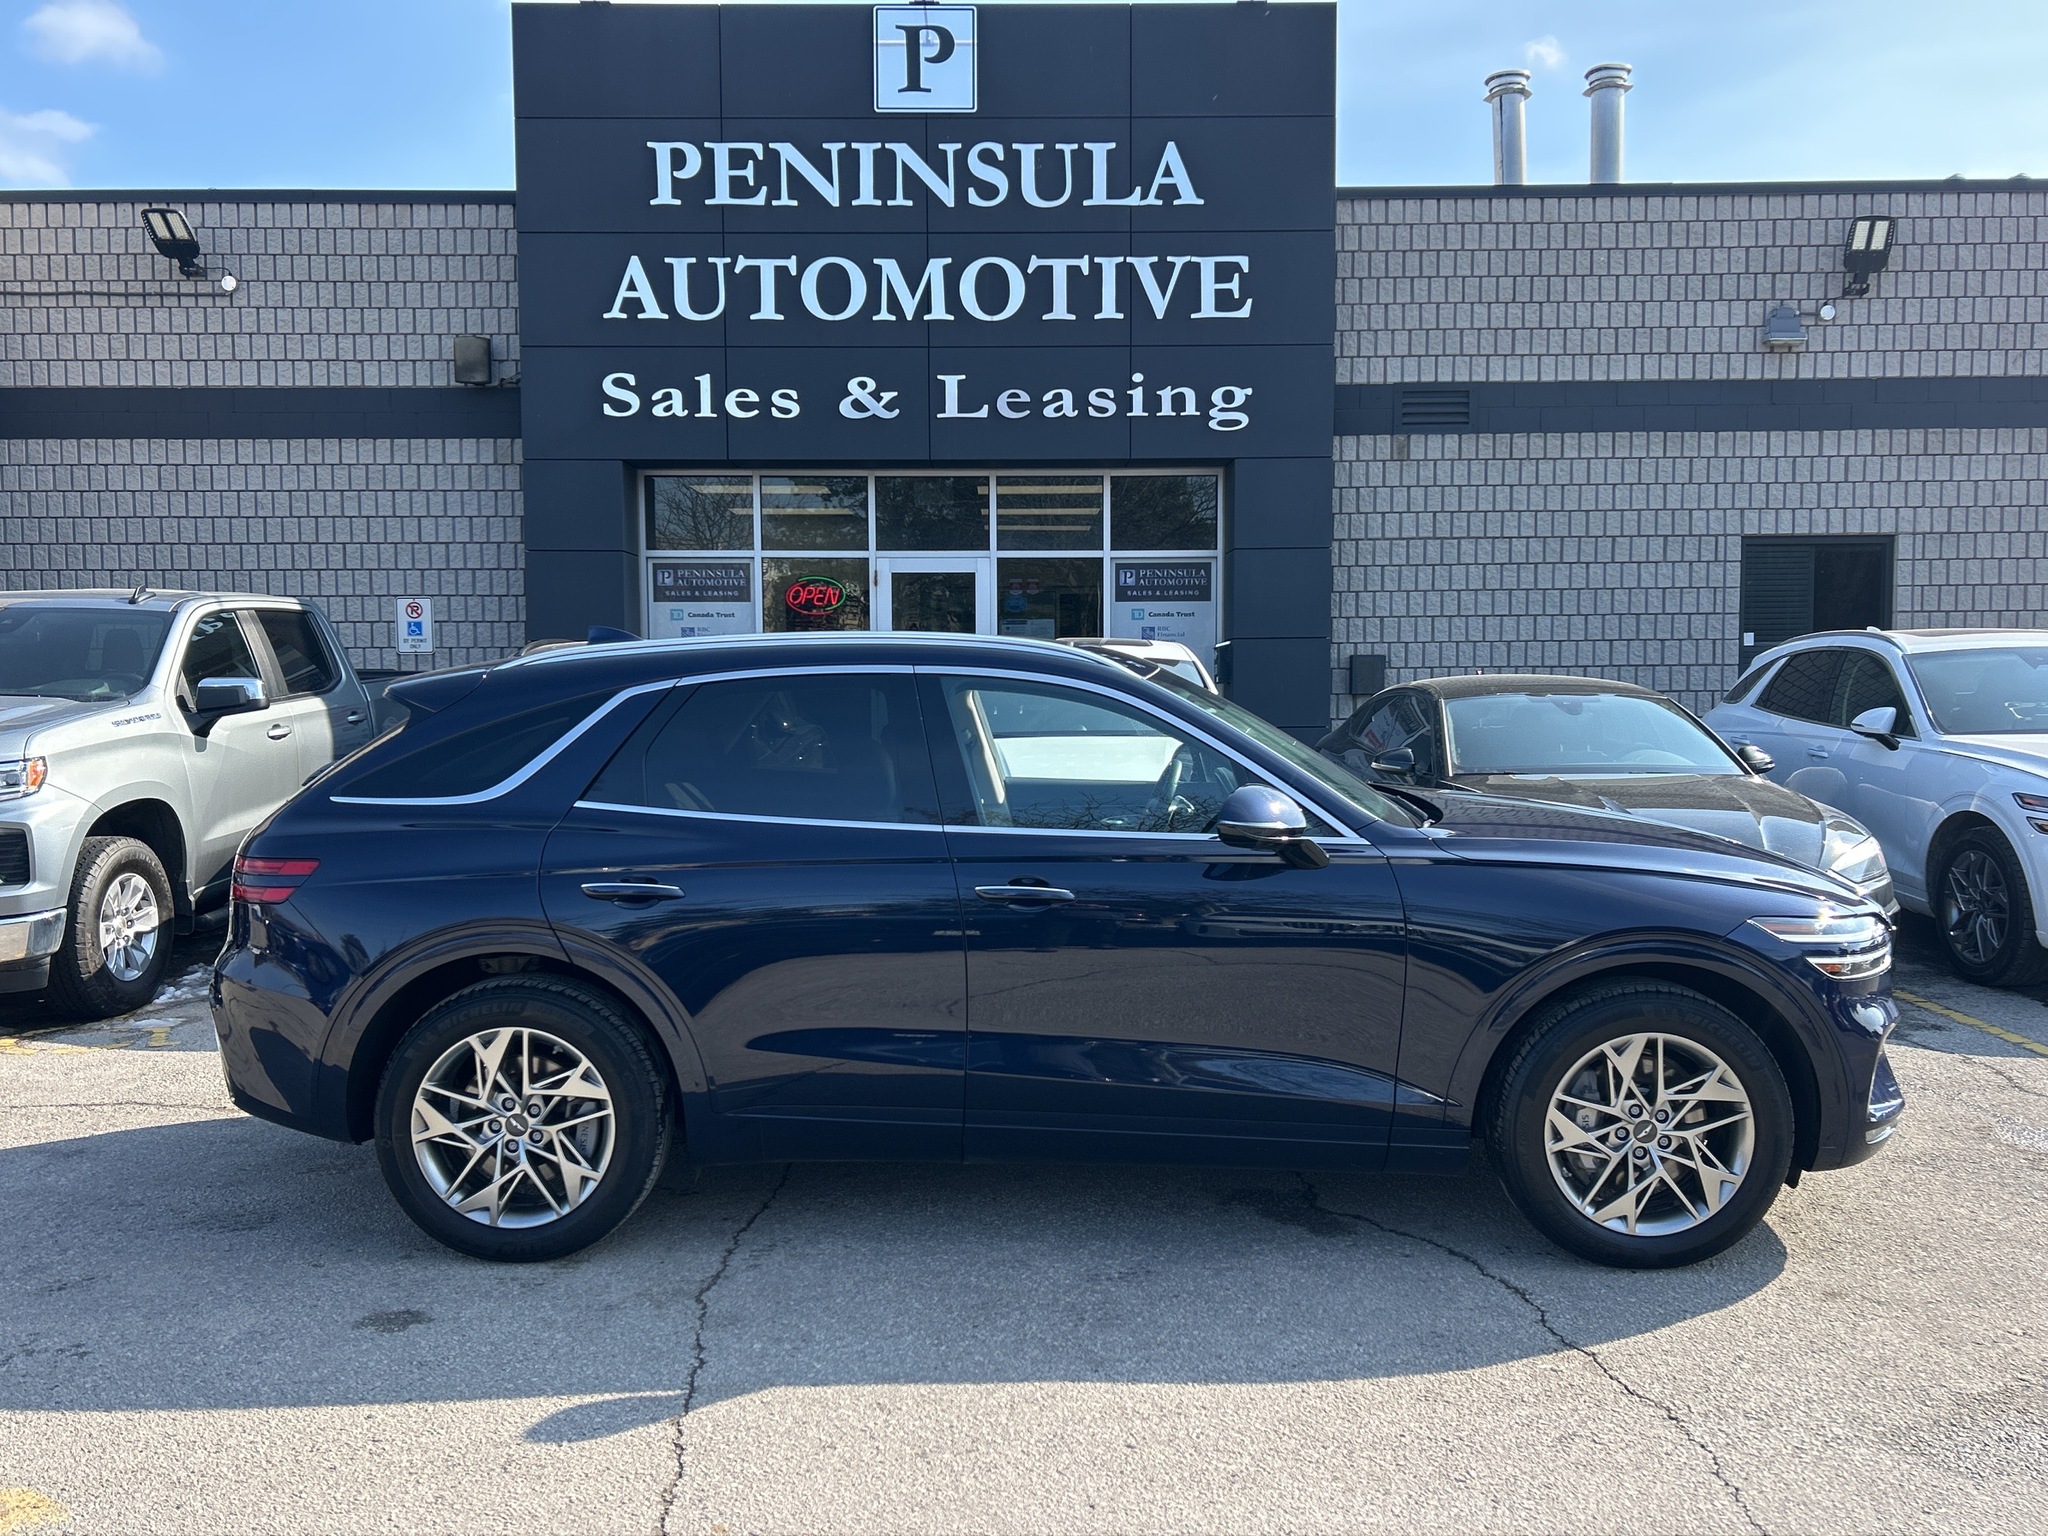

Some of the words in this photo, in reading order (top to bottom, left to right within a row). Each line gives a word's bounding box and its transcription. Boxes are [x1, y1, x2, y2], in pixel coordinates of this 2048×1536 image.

[895, 24, 955, 93] P
[646, 140, 1205, 208] PENINSULA
[602, 255, 1254, 322] AUTOMOTIVE
[601, 372, 801, 419] Sales
[838, 376, 900, 420] &
[936, 372, 1254, 432] Leasing
[660, 570, 672, 585] P
[677, 569, 745, 578] PENINSULA
[1121, 570, 1134, 585] P
[1139, 569, 1206, 577] PENINSULA
[676, 578, 747, 587] AUTOMOTIVE
[1138, 577, 1208, 586] AUTOMOTIVE
[789, 586, 841, 606] OPEN
[1132, 610, 1144, 619] TD
